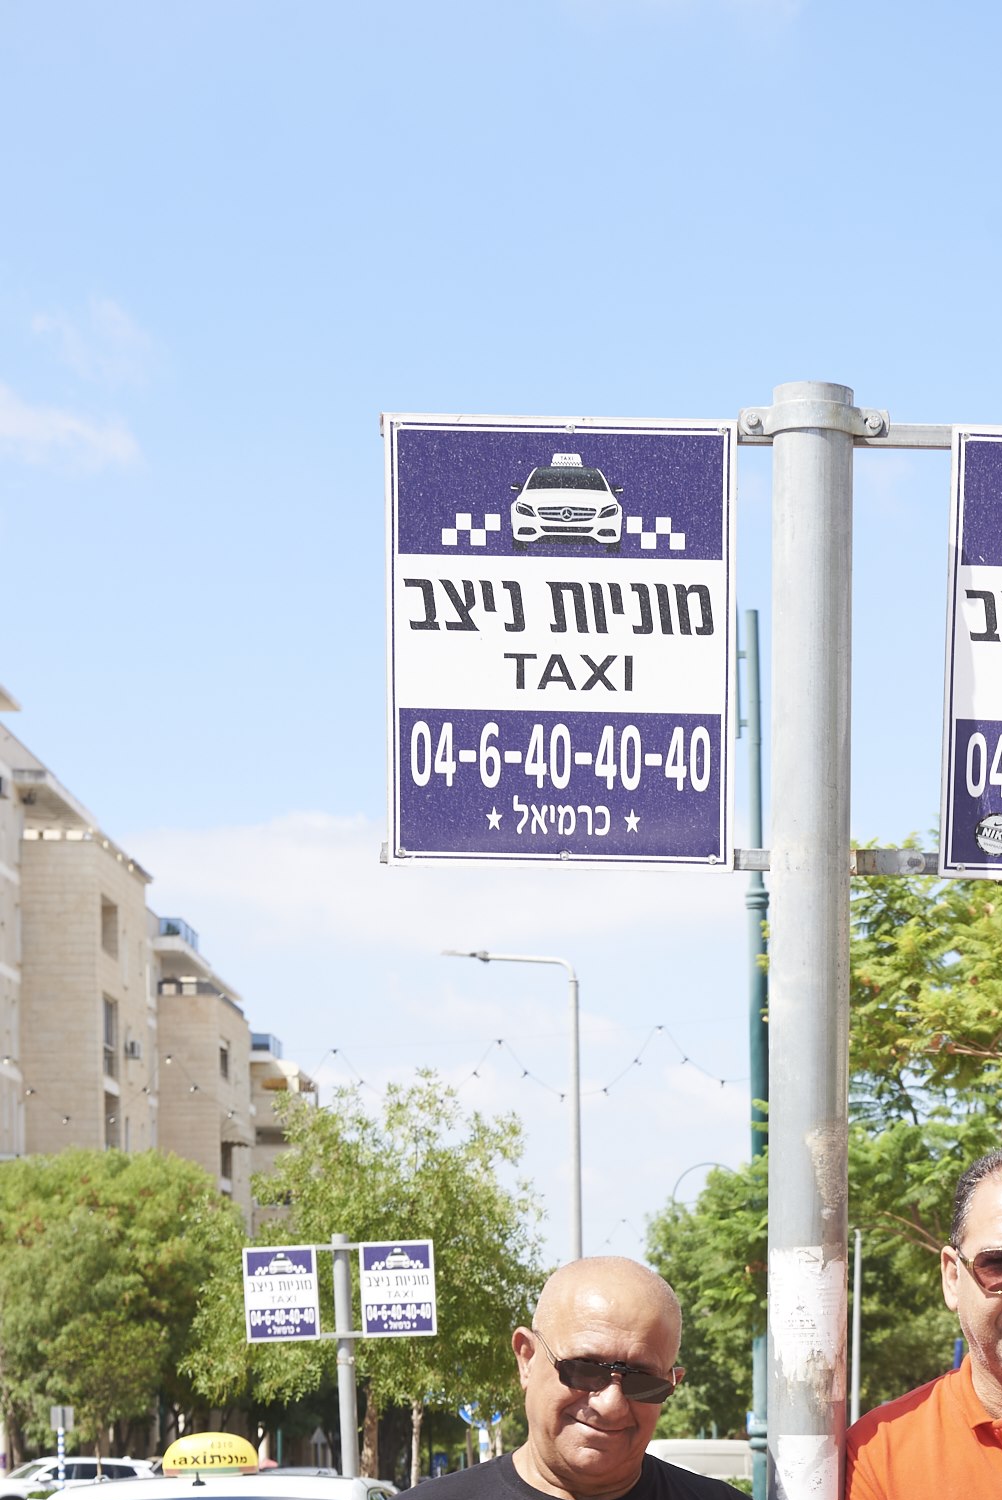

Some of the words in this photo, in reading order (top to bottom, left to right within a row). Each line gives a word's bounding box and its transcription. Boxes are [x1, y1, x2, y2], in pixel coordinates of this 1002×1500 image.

[403, 579, 525, 632] ניצב
[546, 582, 714, 635] מוניות
[504, 653, 633, 691] TAXI
[411, 721, 710, 792] 04-6-40-40-40
[513, 795, 610, 835] כרמיאל
[279, 1280, 312, 1291] מוניות
[365, 1276, 390, 1287] ניצב
[395, 1274, 429, 1286] מוניות
[249, 1281, 274, 1293] ניצב
[271, 1295, 297, 1303] TAXI
[387, 1290, 414, 1298] TAXI
[250, 1307, 315, 1326] 04-6-40-40-40
[366, 1303, 431, 1321] 04-6-40-40-40
[173, 1452, 207, 1465] taxi
[210, 1454, 247, 1465] מונית
